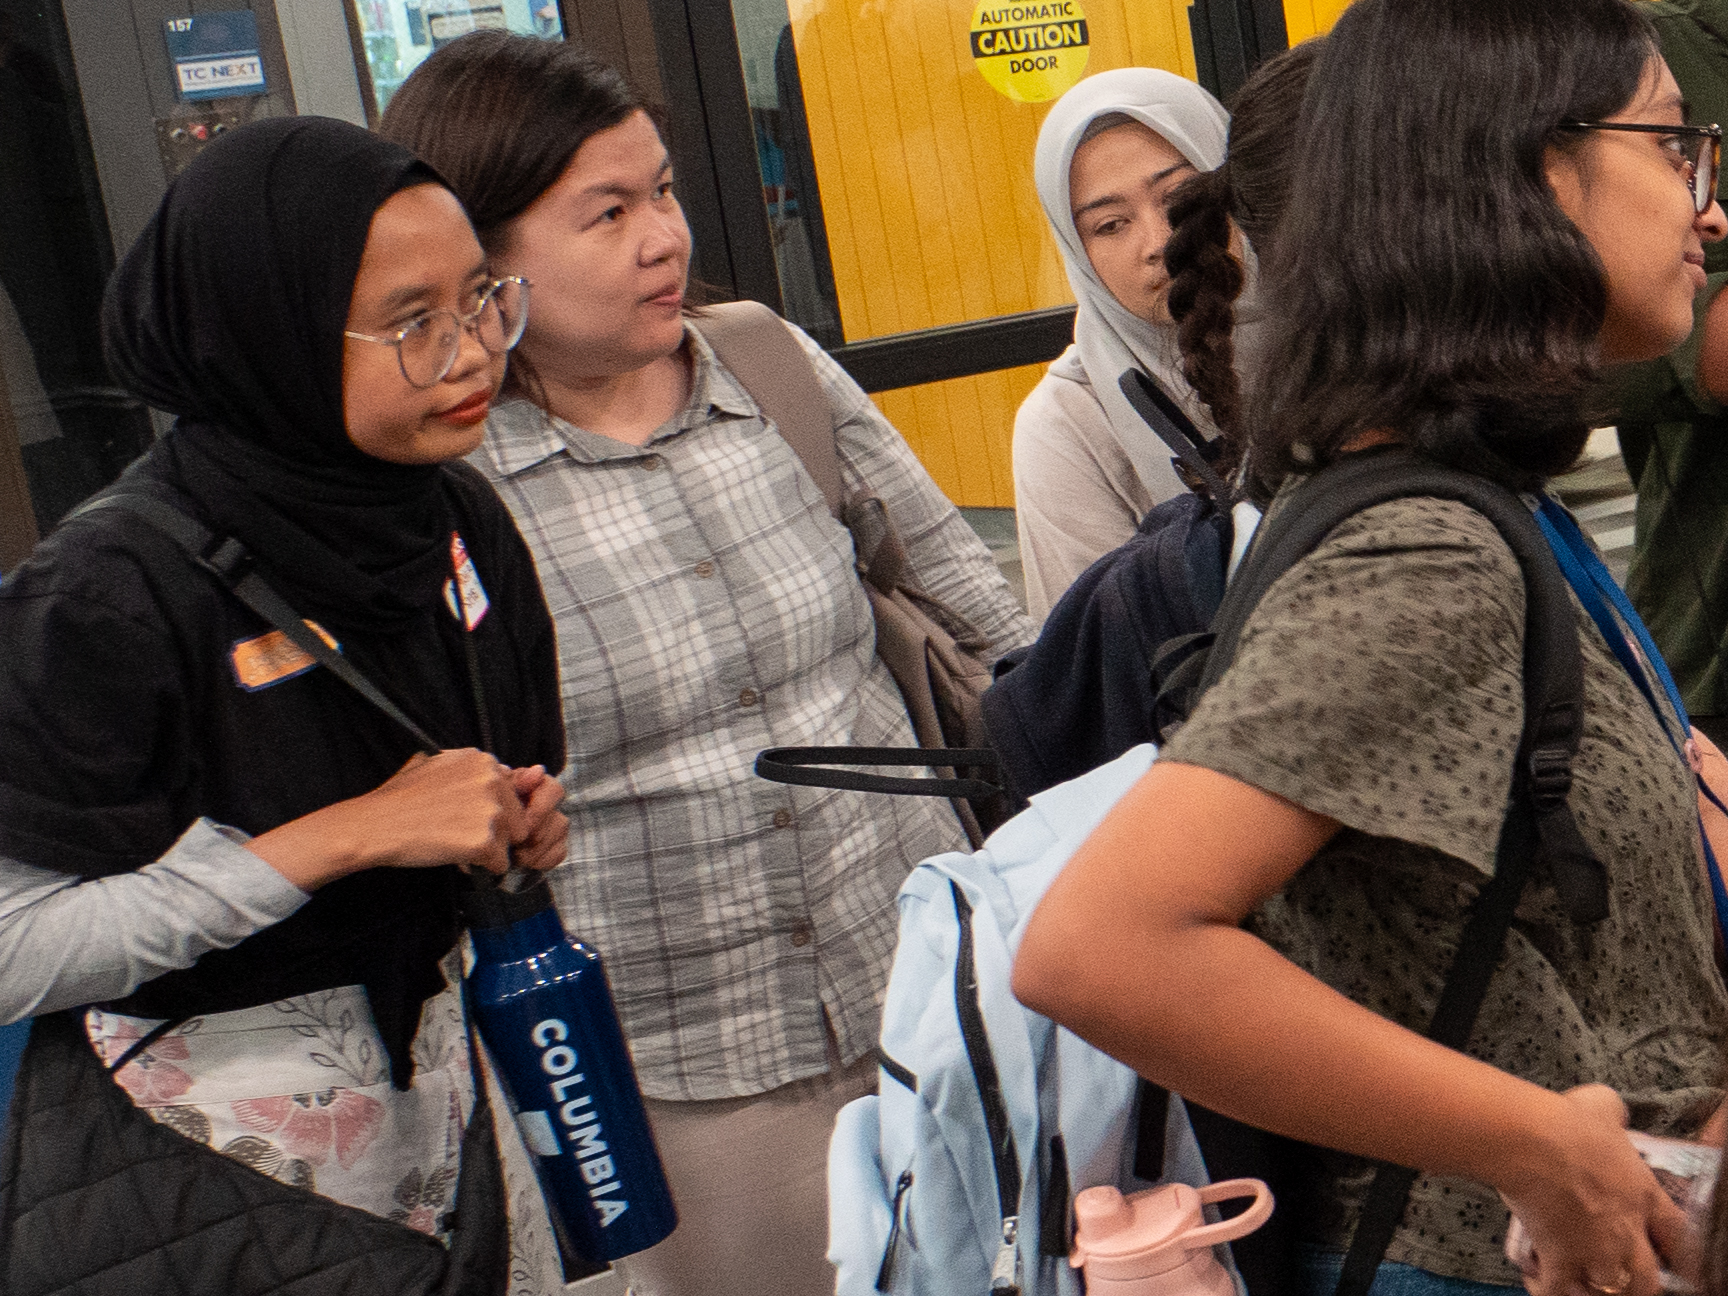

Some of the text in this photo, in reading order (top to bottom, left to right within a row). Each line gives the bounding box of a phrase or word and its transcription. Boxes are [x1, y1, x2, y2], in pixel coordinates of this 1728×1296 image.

[980, 1, 1073, 25] AUTOMATIC
[168, 18, 193, 32] 157
[978, 23, 1082, 55] CAUTION
[183, 63, 258, 80] TC NEXT
[1010, 56, 1058, 74] DOOR
[531, 1018, 630, 1228] COLUMBIA
